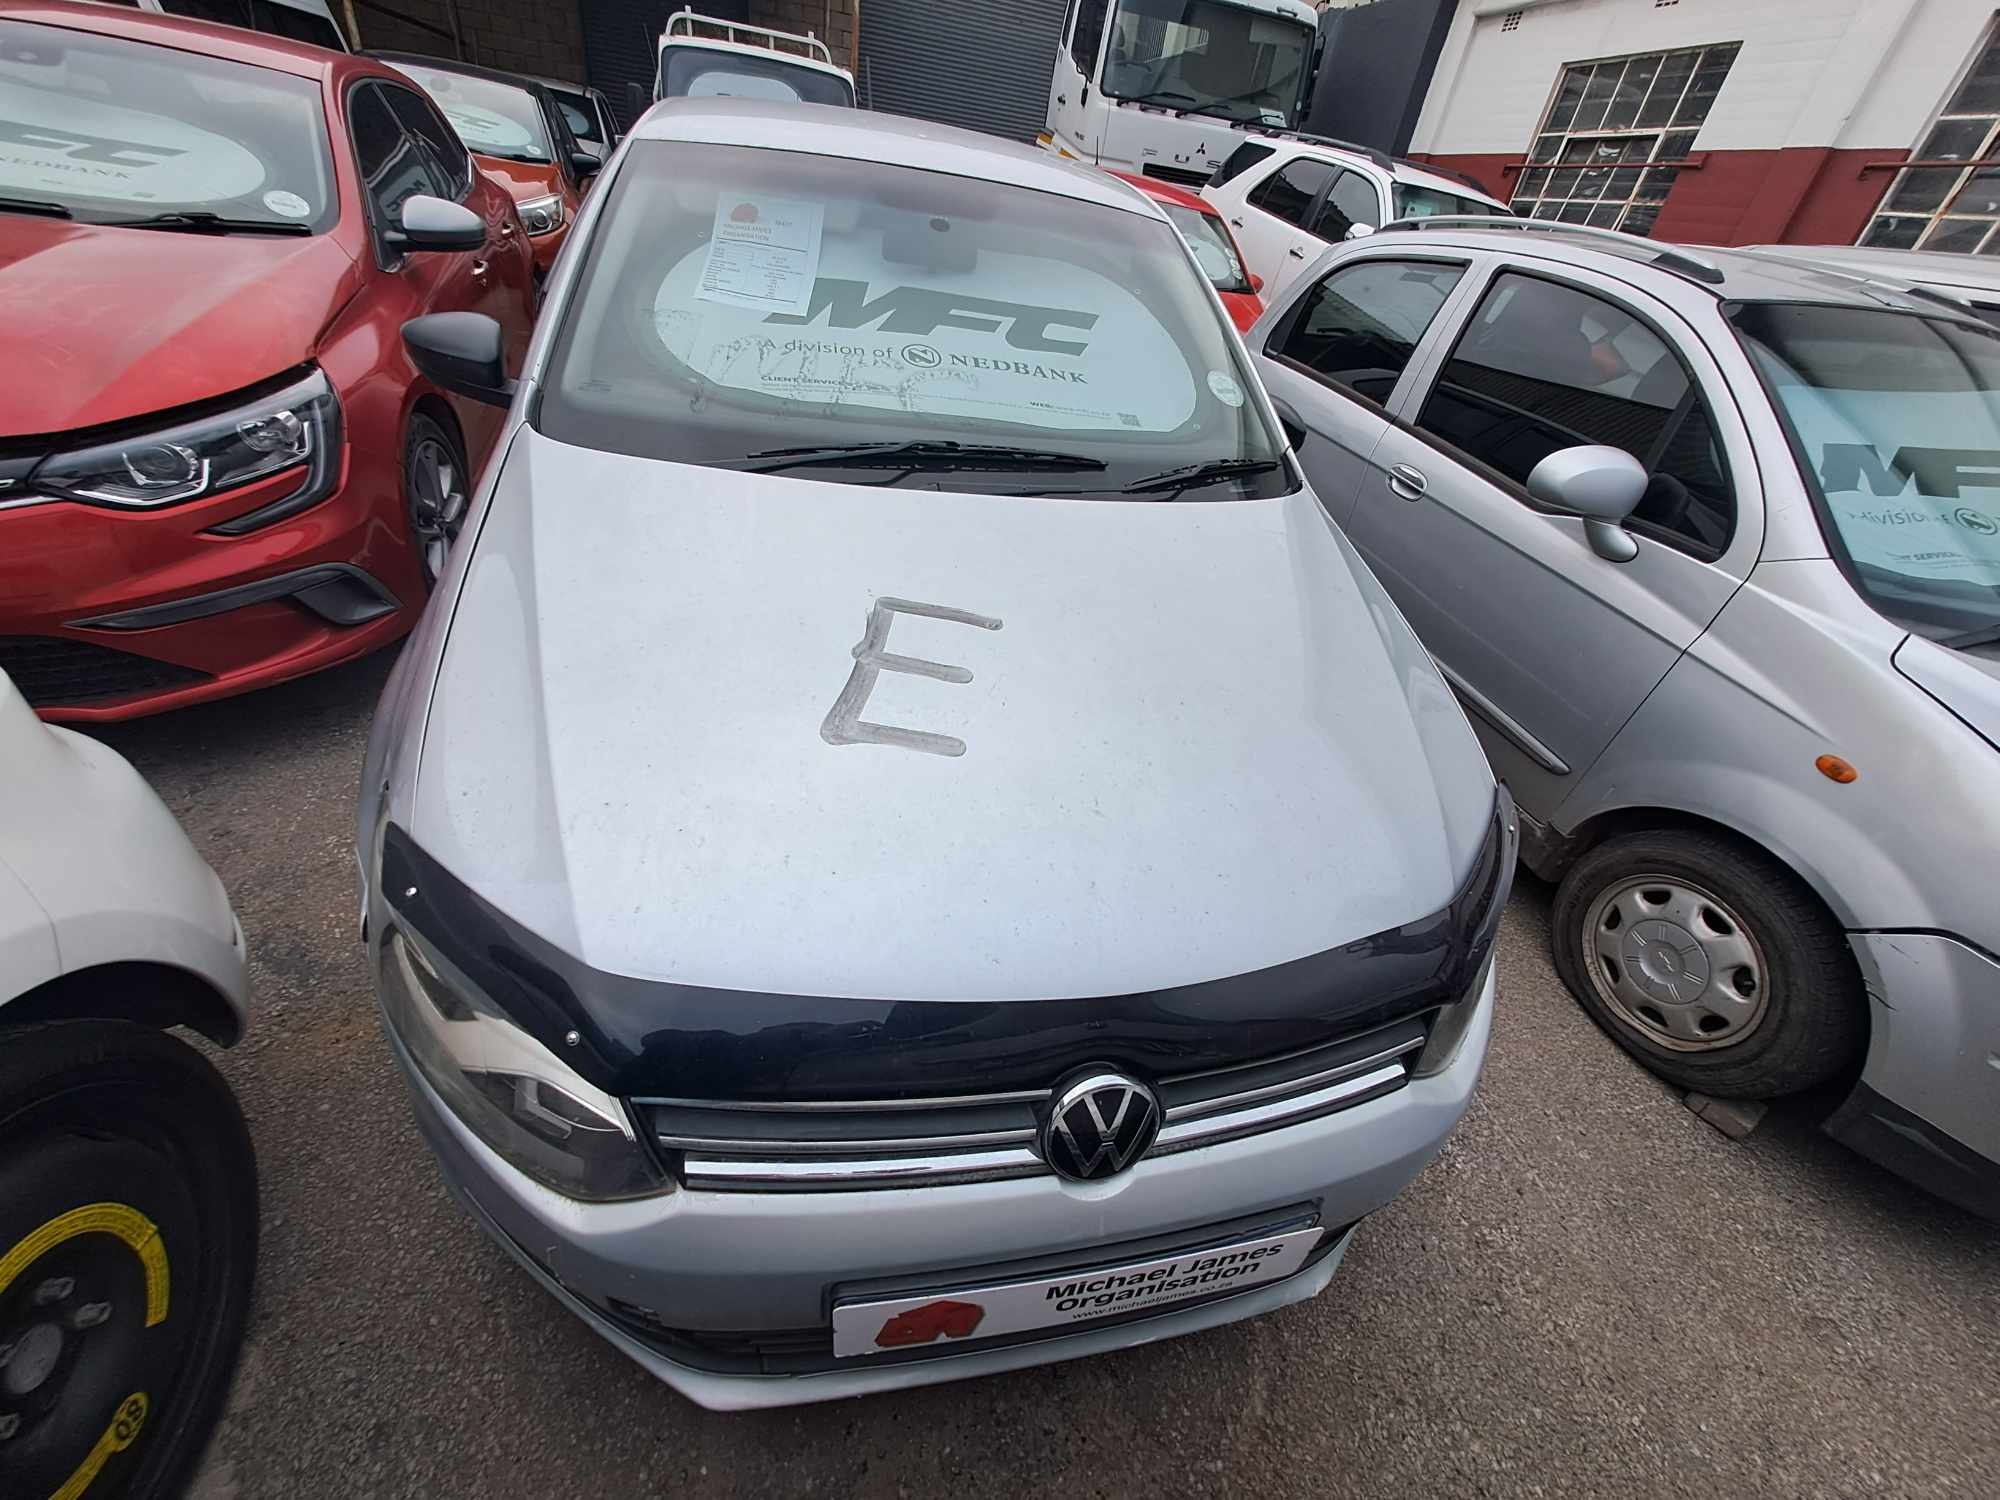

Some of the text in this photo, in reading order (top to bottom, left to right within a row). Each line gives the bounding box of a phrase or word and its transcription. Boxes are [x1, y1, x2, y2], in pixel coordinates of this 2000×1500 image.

[762, 277, 1099, 357] MFC
[761, 338, 777, 350] A
[784, 339, 865, 357] division
[872, 346, 893, 360] of
[949, 354, 1088, 385] NEDBANK
[820, 596, 1004, 757] E
[1045, 1243, 1284, 1300] Michael James
[1055, 1261, 1261, 1312] Organisation
